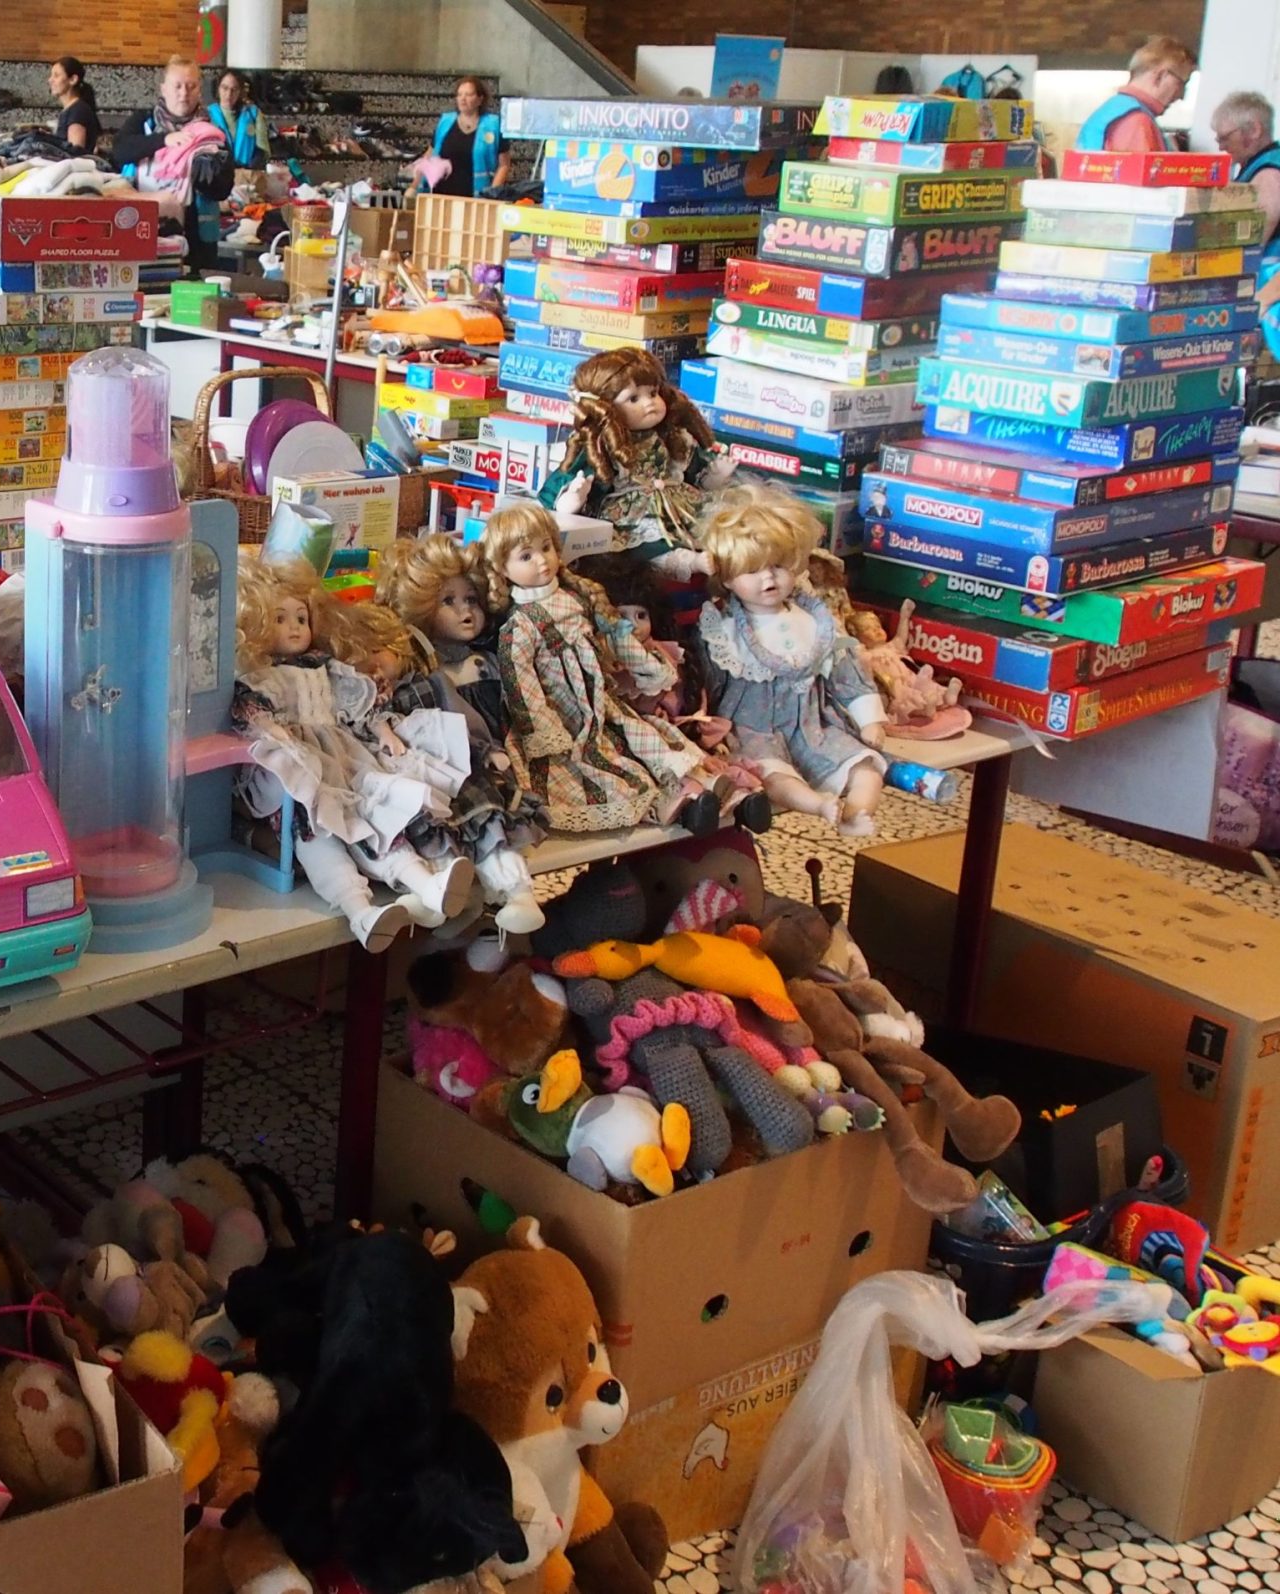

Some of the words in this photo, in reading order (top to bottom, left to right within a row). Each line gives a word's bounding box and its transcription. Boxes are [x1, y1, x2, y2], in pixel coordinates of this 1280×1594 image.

[578, 104, 689, 130] INKOGNITO
[559, 158, 597, 182] Kinder
[702, 162, 741, 187] Kinder
[919, 183, 965, 210] GRIPS
[965, 182, 1006, 199] Champion
[775, 217, 867, 256] BLUFF
[922, 225, 1002, 260] BLUFF
[40, 248, 69, 257] SHARED
[69, 248, 94, 257] FLOOR
[94, 248, 120, 257] PUZZLE
[579, 310, 631, 331] Sagaland
[757, 309, 818, 335] LINGUA
[1152, 341, 1202, 361] Wissens-Quiz
[1202, 340, 1212, 354] für
[1212, 339, 1234, 353] Kinder
[501, 352, 538, 376] AUF
[943, 368, 1049, 415] ACQUIRE
[1103, 373, 1178, 418] ACQUIRE
[452, 445, 473, 457] PARKER
[731, 447, 798, 476] SCRABBLE
[25, 464, 49, 476] 2x20
[322, 489, 342, 498] Hier
[342, 486, 371, 497] wohne
[371, 484, 386, 494] ich
[906, 500, 981, 525] MONOPOLY
[1056, 518, 1106, 537] MONOPOLY
[888, 530, 964, 562] Barbarossa
[1079, 555, 1146, 584] Barbarossa
[946, 574, 1004, 601] Blokus
[1170, 594, 1205, 617] Blokus
[1093, 641, 1148, 677] Shogun
[765, 1378, 799, 1404] EIER
[726, 1393, 760, 1418] AUS
